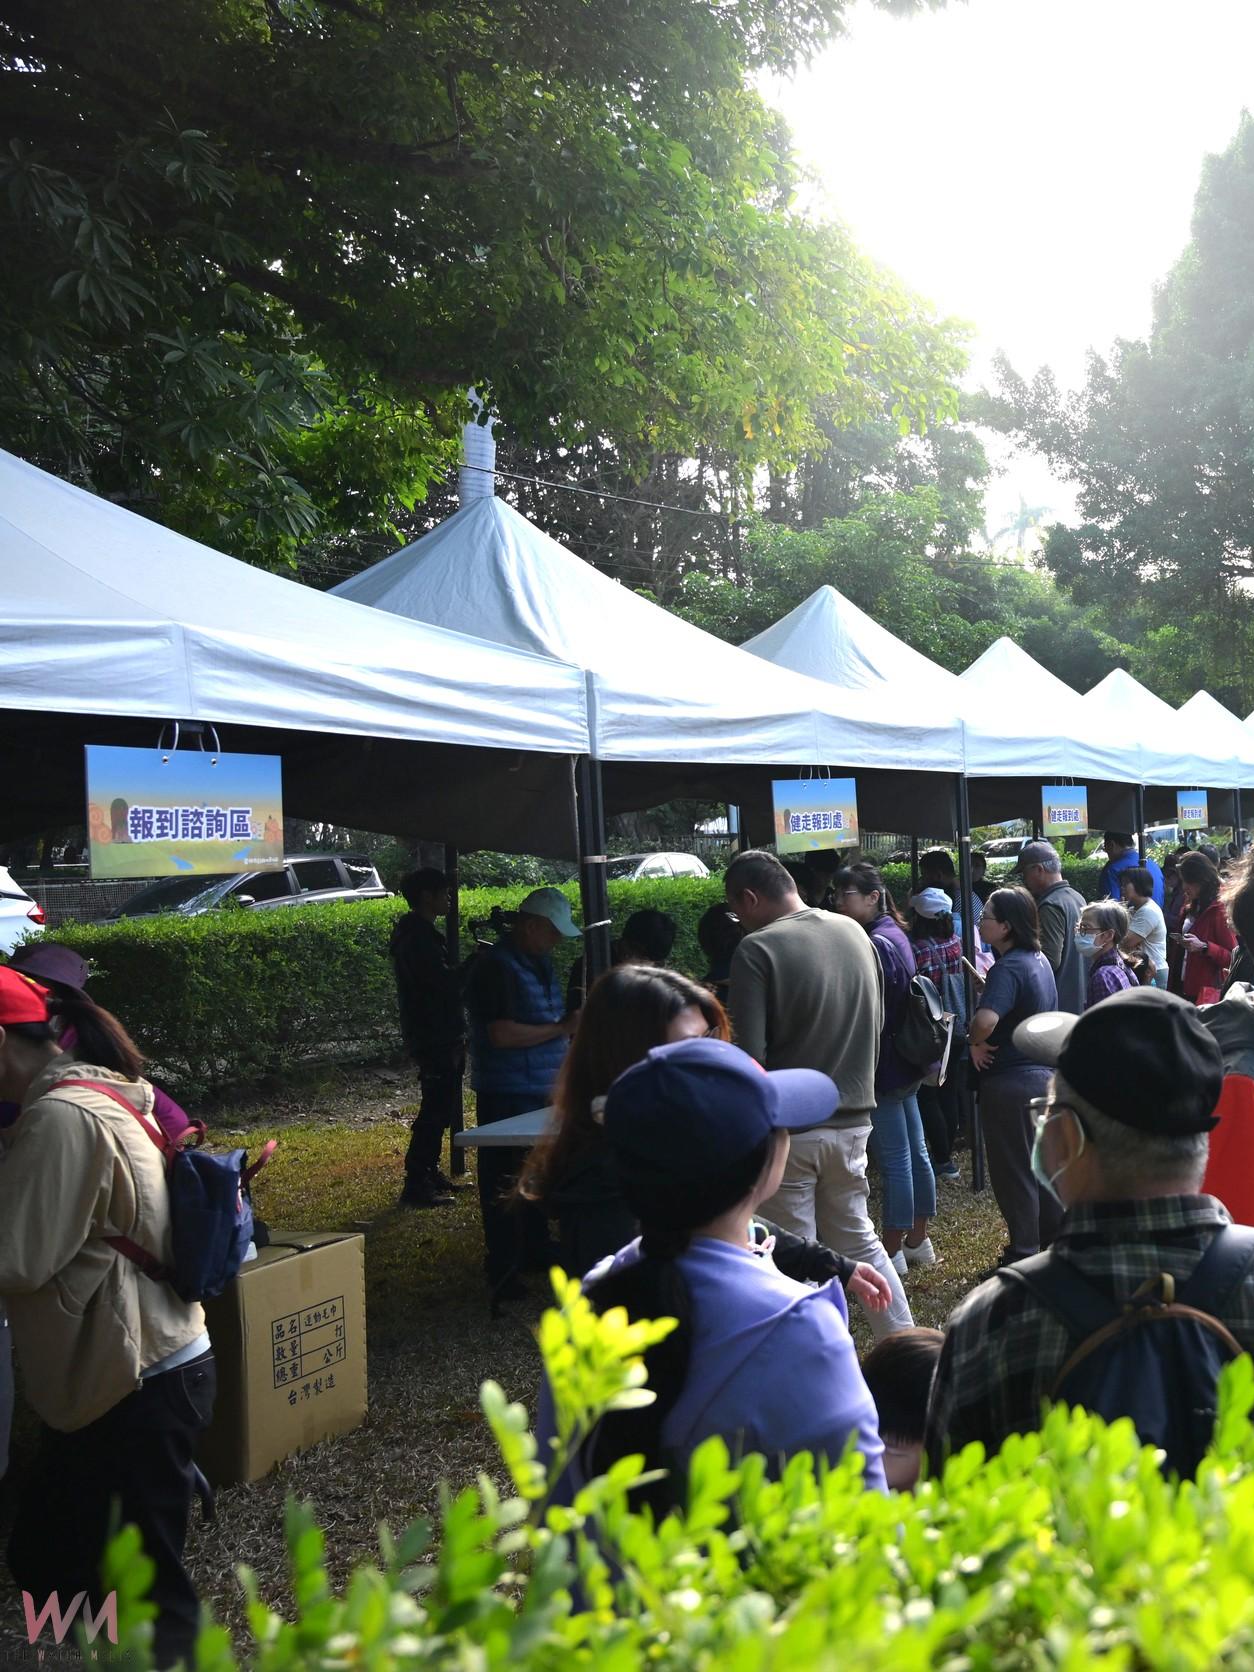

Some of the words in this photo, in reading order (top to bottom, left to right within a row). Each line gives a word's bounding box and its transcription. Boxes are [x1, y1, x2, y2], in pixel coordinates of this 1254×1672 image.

[129, 807, 252, 841] 報到諮詢區
[790, 811, 843, 833] 健走報到處
[275, 1319, 298, 1340] 品名
[304, 1304, 337, 1327] 運動毛巾
[275, 1339, 299, 1361] 數量
[335, 1323, 343, 1338] 打
[275, 1361, 299, 1383] 總重
[323, 1342, 343, 1364] 公斤
[288, 1373, 337, 1406] 台灣製造
